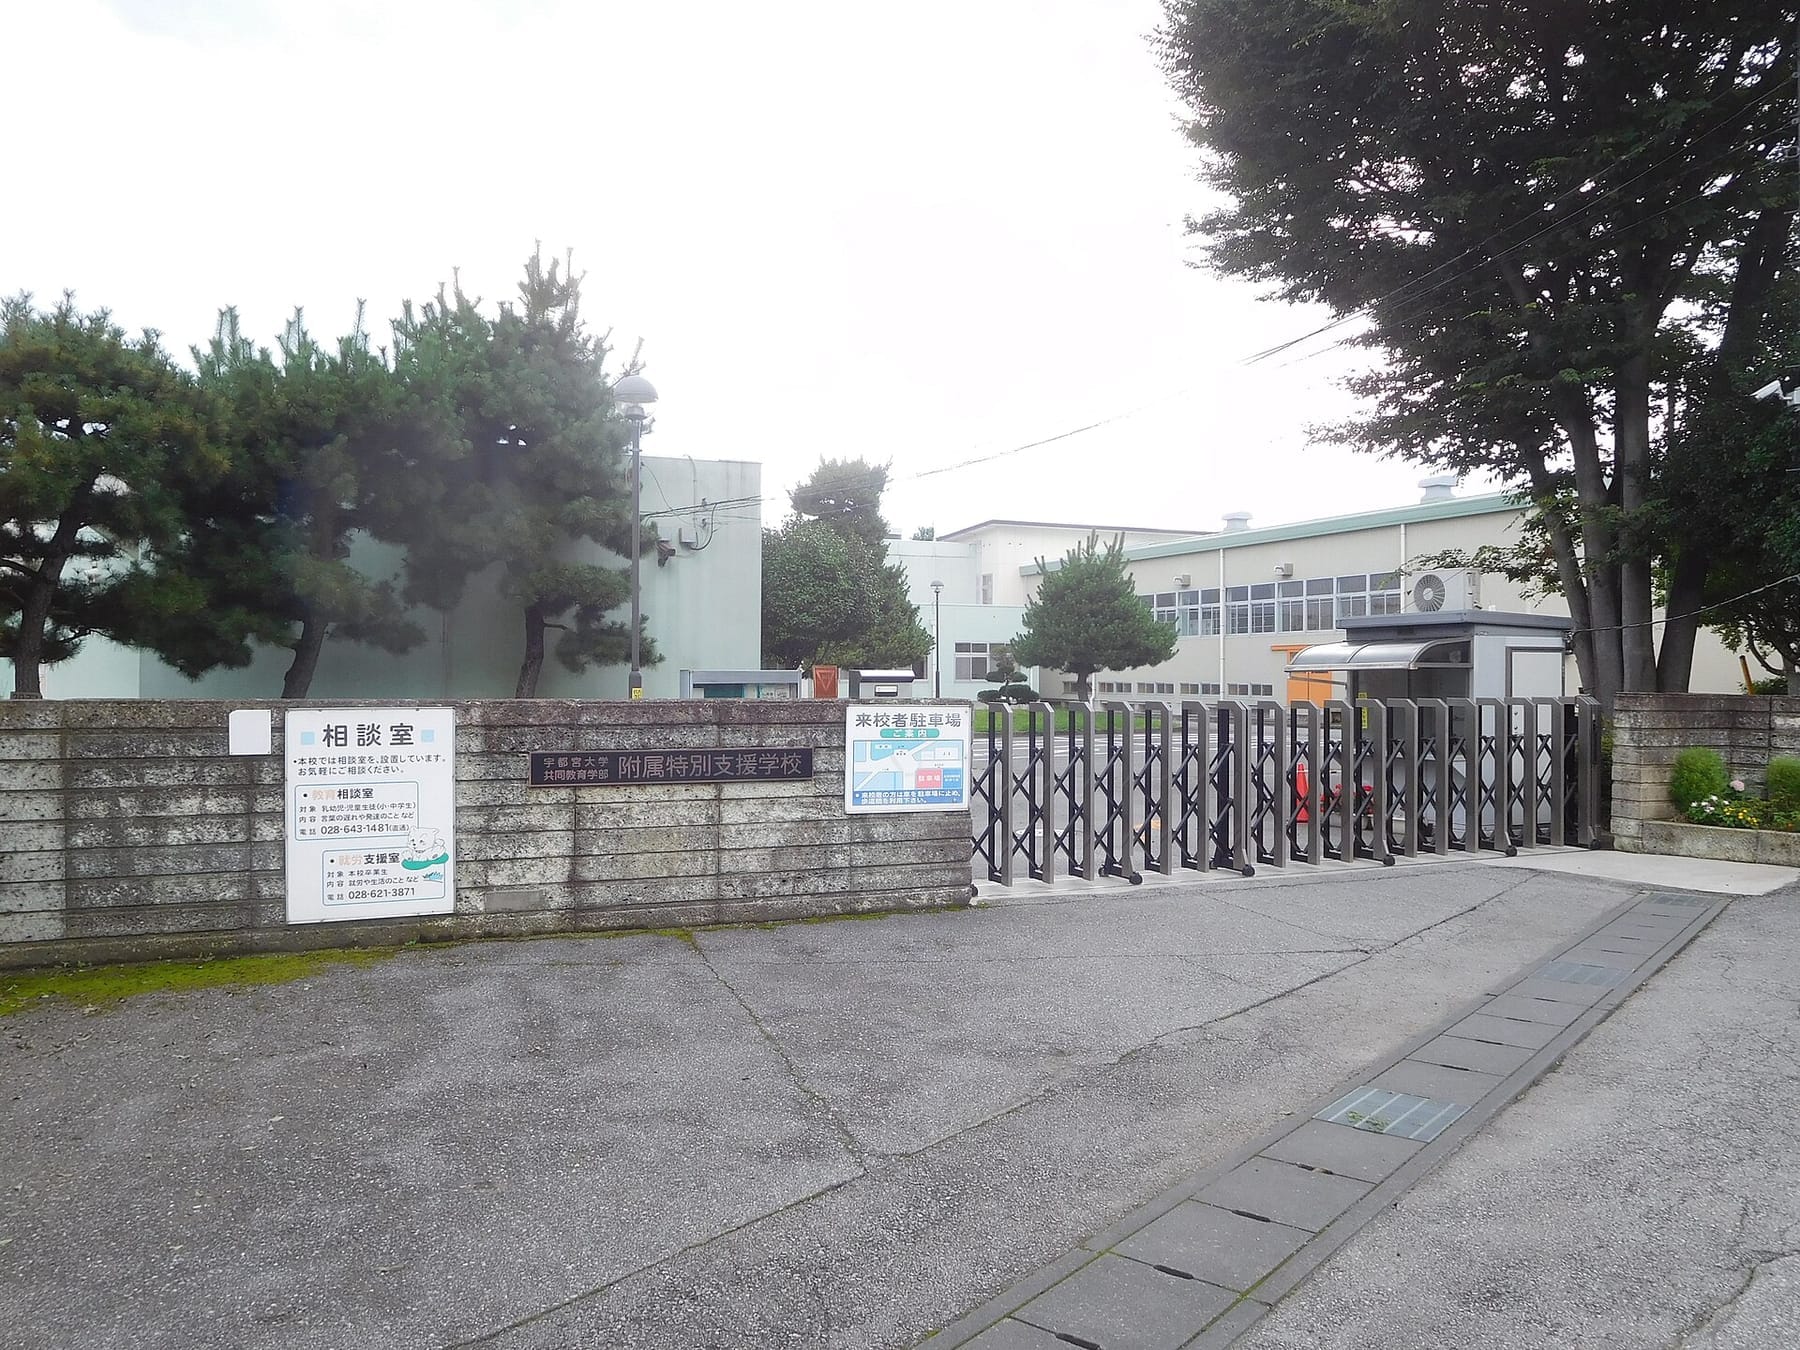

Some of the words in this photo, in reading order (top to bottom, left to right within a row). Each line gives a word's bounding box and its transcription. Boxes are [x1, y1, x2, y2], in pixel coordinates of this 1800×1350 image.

[855, 712, 961, 727] 来校者駐車場
[322, 723, 414, 748] 相談室
[893, 729, 927, 738] ご案内
[543, 756, 609, 768] 宇都宮大学
[618, 753, 802, 779] 附属特別支援学校
[298, 766, 404, 776] お気軽にご相談ください。
[543, 768, 609, 781] 共同教育学部
